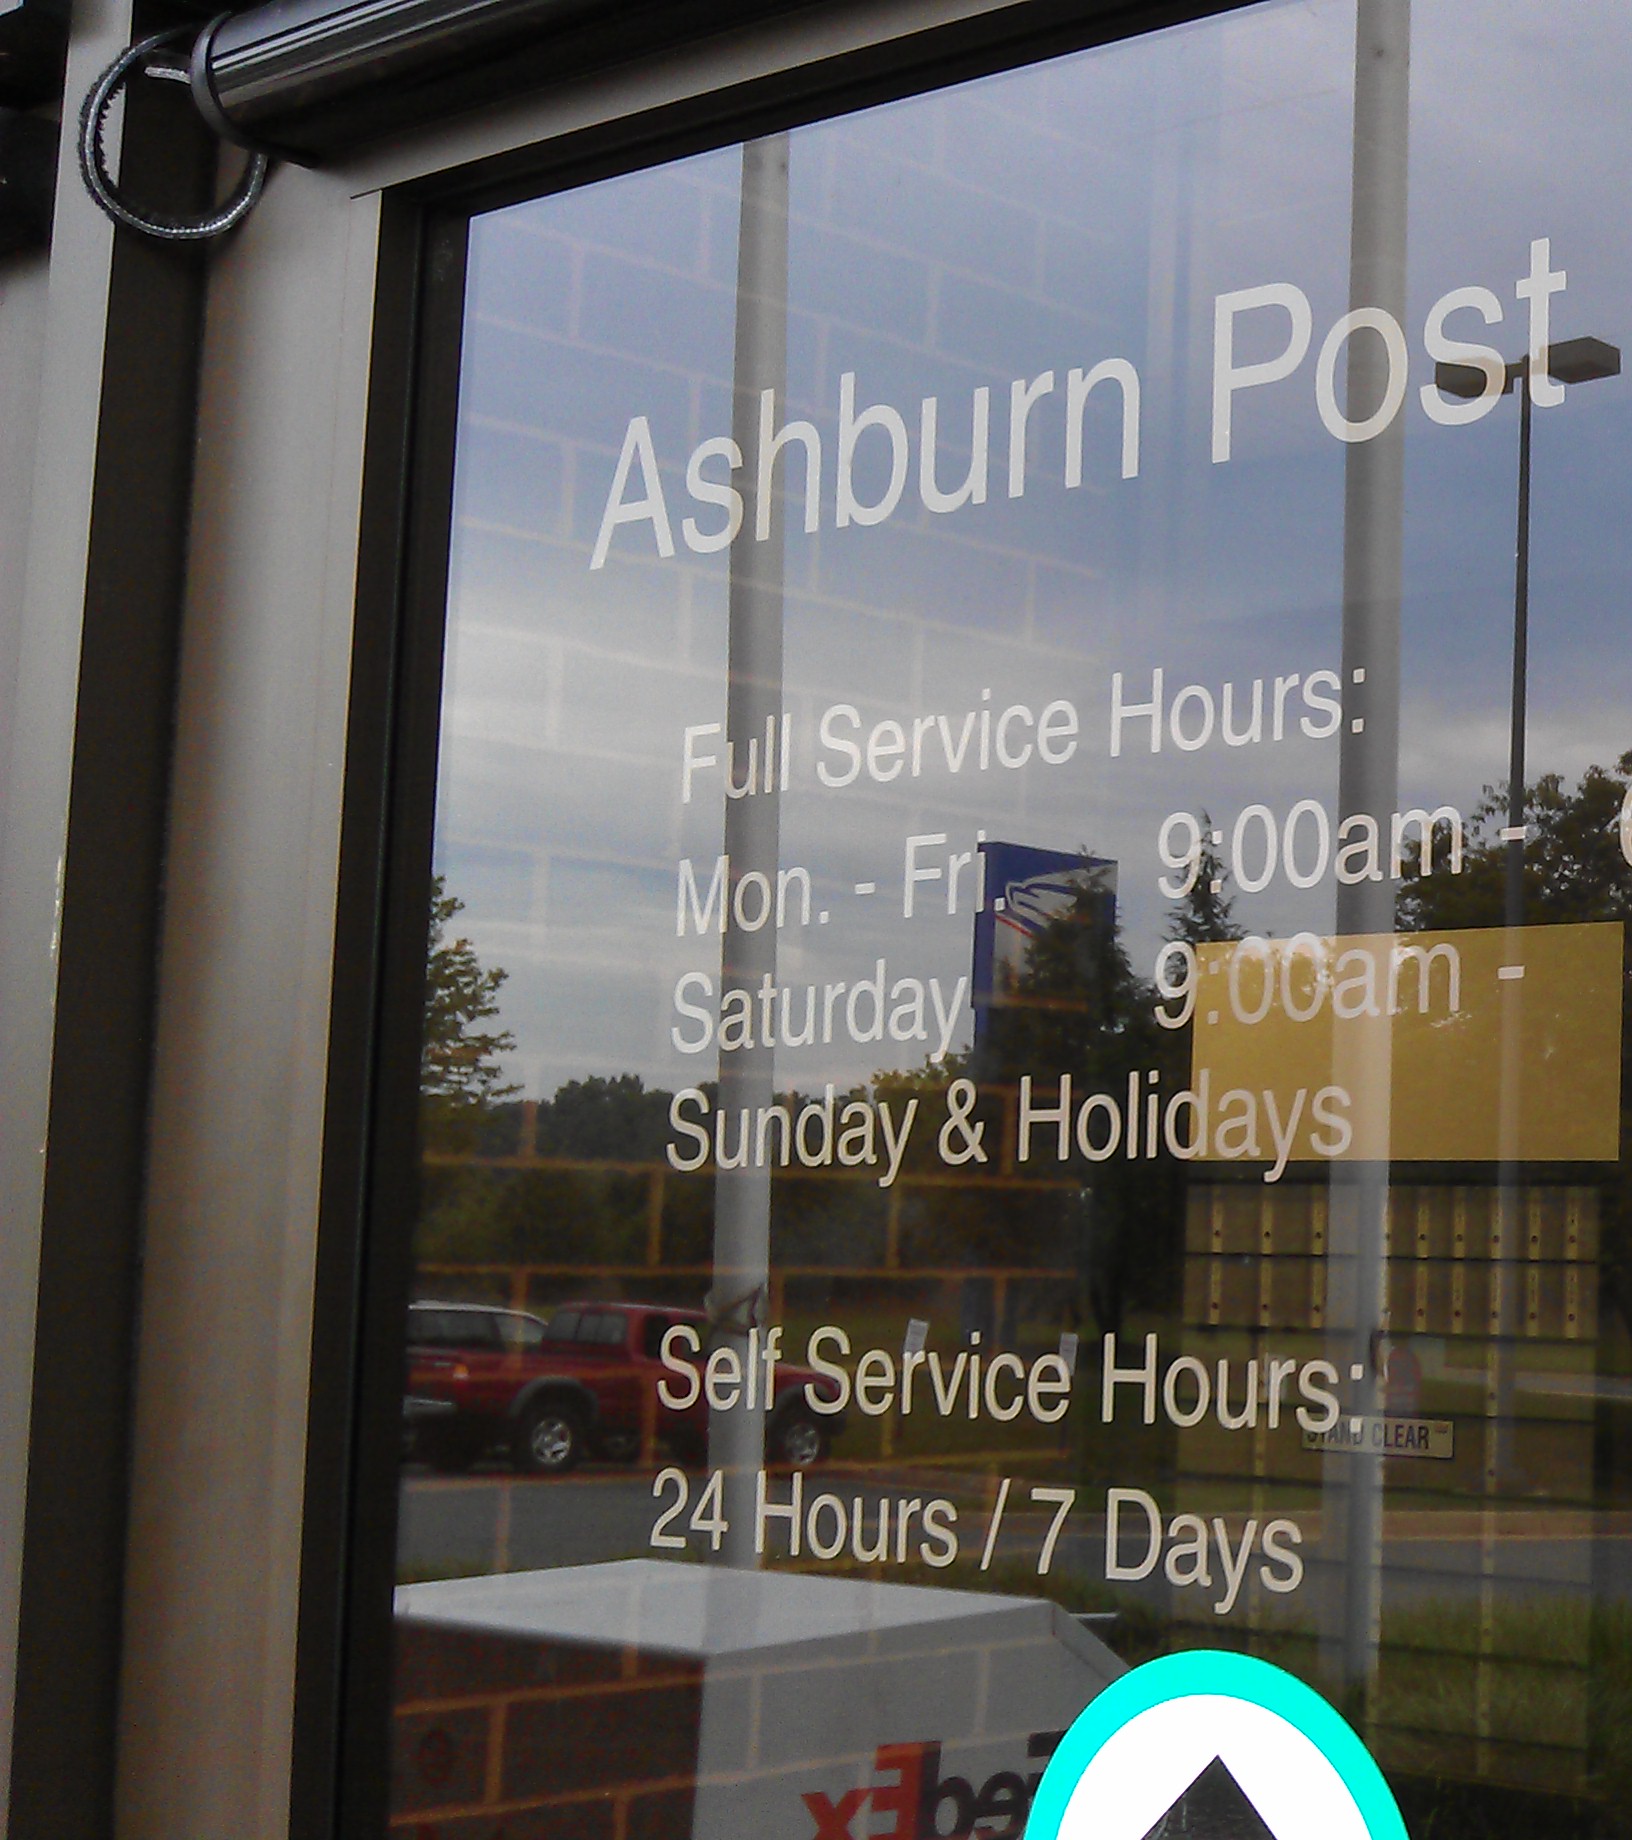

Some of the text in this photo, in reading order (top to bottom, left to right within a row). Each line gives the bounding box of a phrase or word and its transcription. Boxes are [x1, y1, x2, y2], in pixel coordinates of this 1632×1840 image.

[589, 357, 1140, 570] Ashburn
[1211, 237, 1567, 464] Post
[680, 667, 1367, 802] Full Service Hours:
[675, 855, 830, 937] Mon.
[854, 881, 876, 895] -
[903, 830, 1006, 918] Fri.
[1157, 800, 1463, 899] 9:00am
[1500, 826, 1527, 840] -
[670, 959, 969, 1063] Saturday
[1154, 932, 1461, 1031] 9:00am
[1497, 965, 1525, 980] -
[666, 1084, 918, 1188] Sunday
[938, 1078, 988, 1164] &
[1017, 1069, 1354, 1183] Holidays
[656, 1325, 1365, 1434] Self Service Hours:
[1372, 1423, 1430, 1449] CLEAR
[648, 1467, 1304, 1616] 24 Hours / 7 Days
